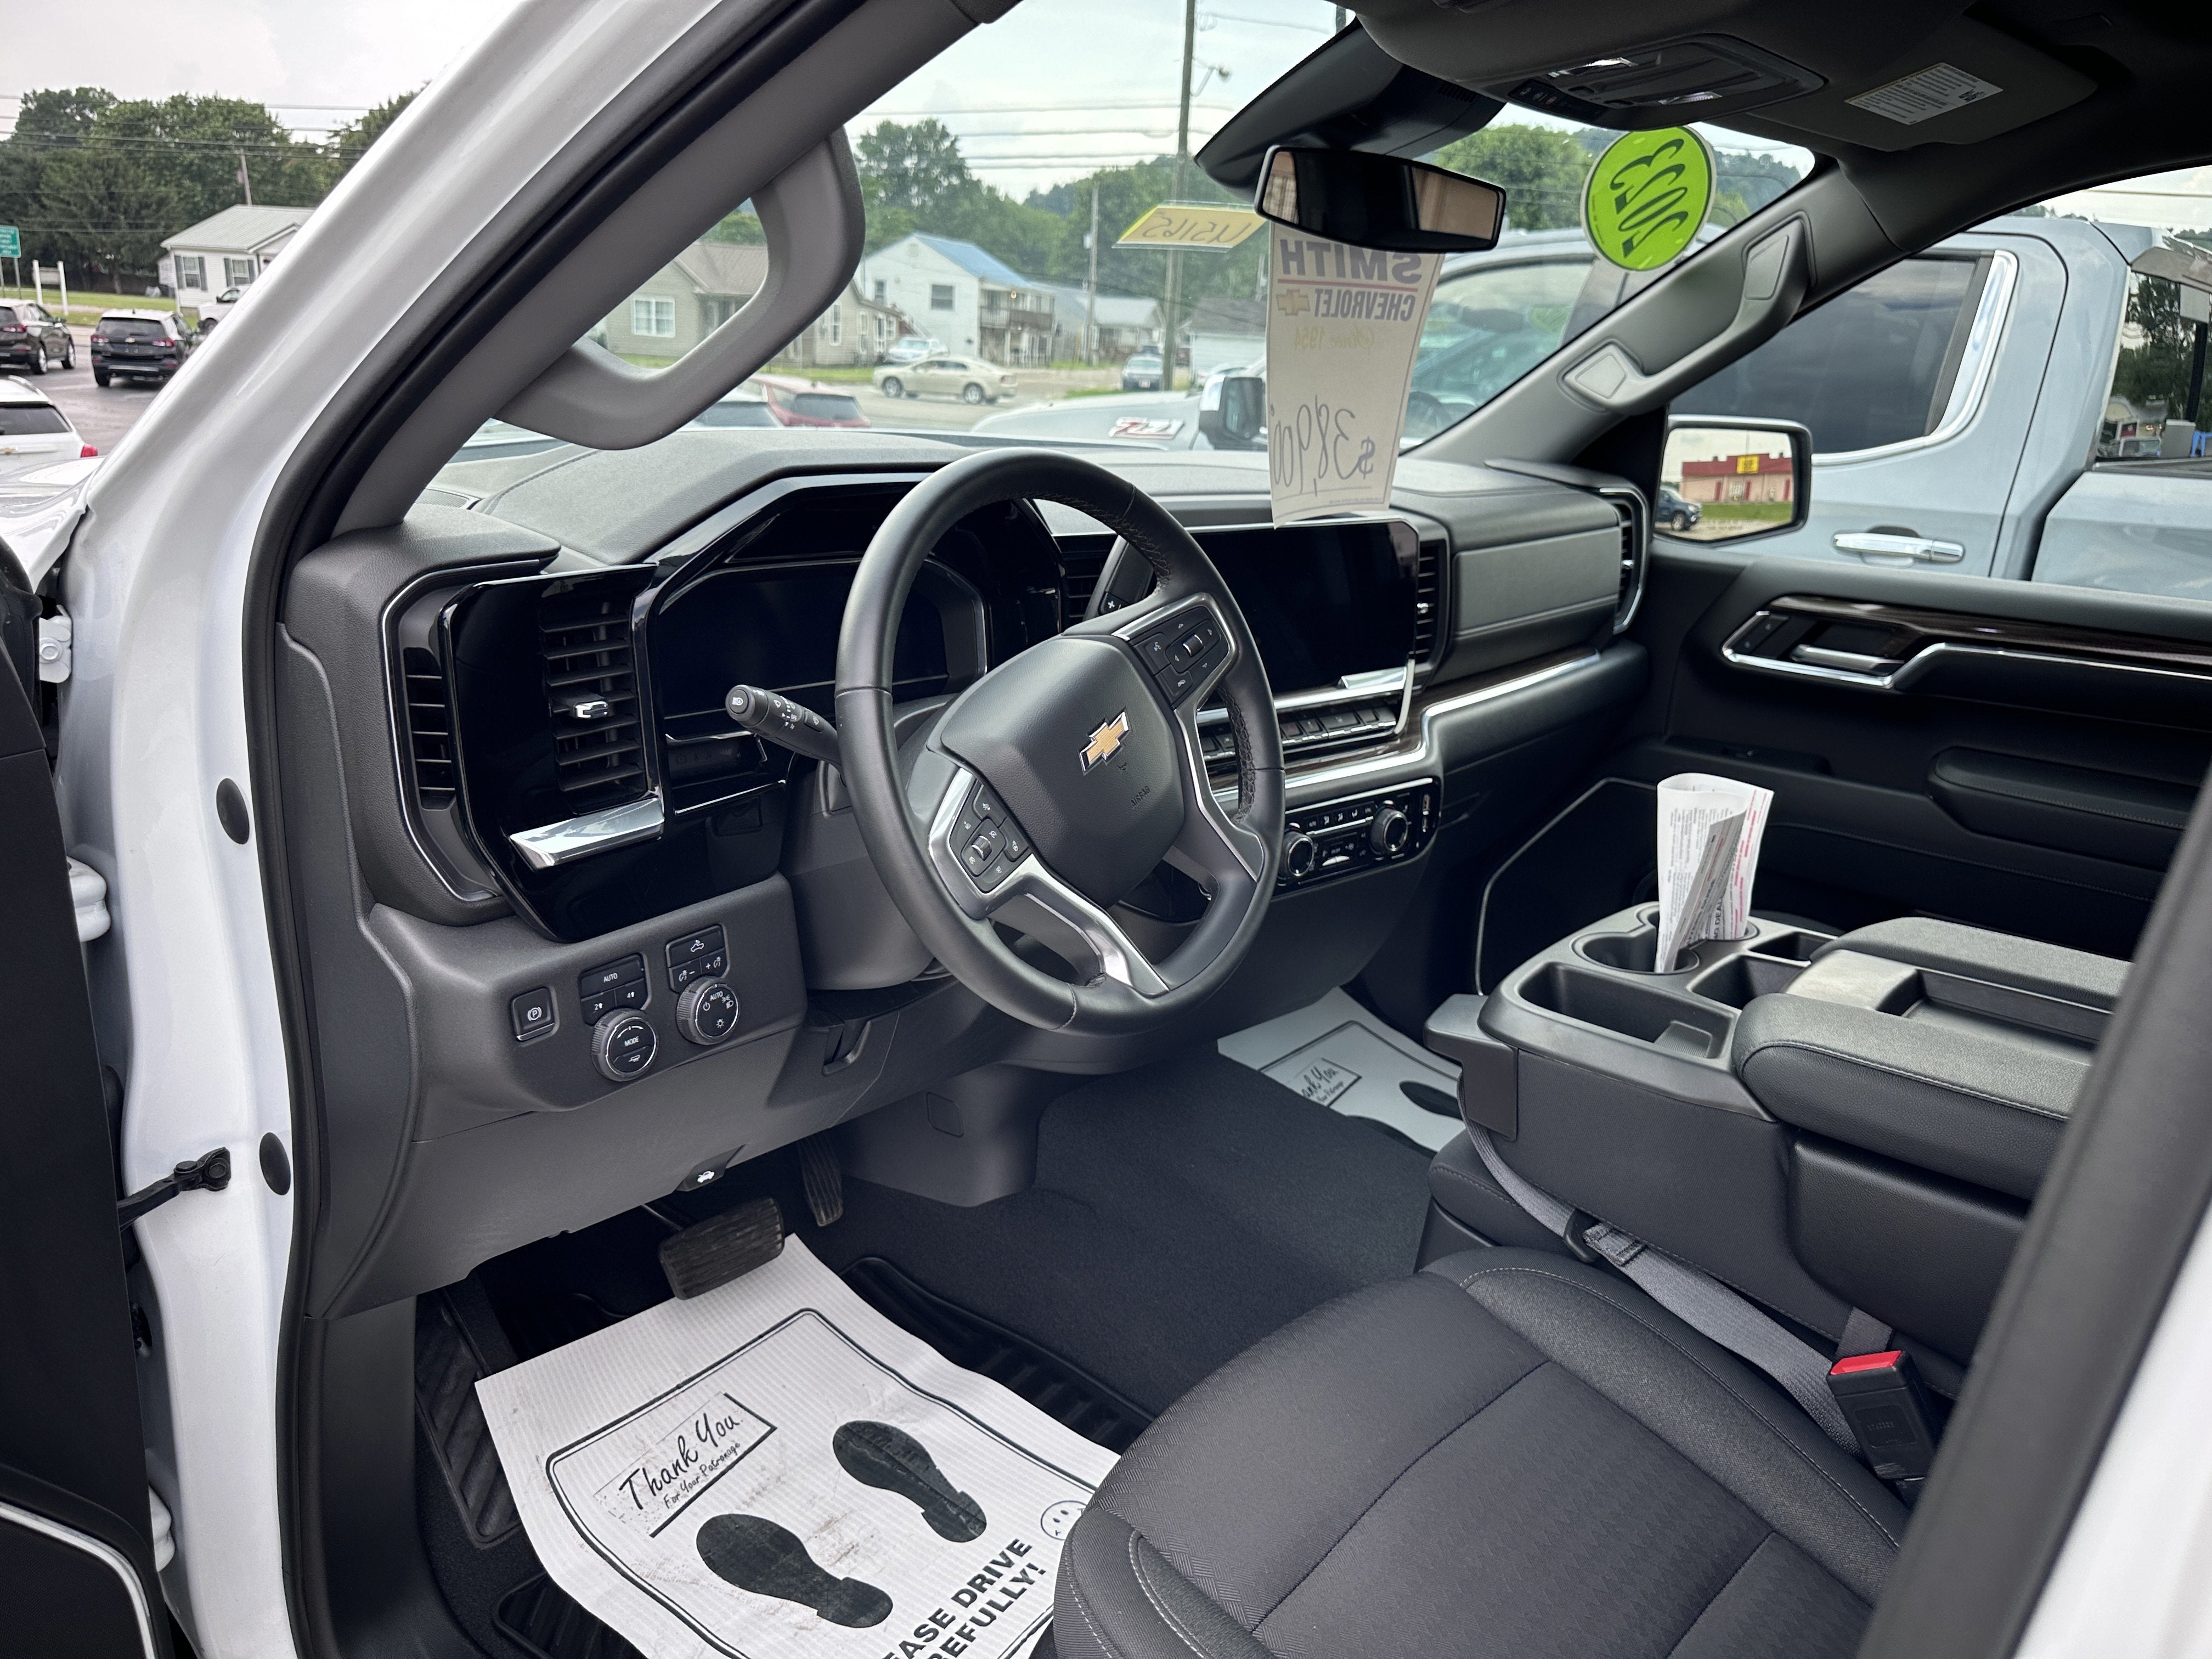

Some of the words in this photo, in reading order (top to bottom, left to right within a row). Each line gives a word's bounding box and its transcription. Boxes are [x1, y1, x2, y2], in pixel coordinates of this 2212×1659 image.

[603, 973, 618, 983] AUTO
[710, 991, 723, 1001] AUTO
[624, 1036, 640, 1047] MODE
[618, 1435, 698, 1510] Thank
[695, 1412, 740, 1447] You
[663, 1493, 681, 1509] For
[680, 1480, 701, 1493] Your
[699, 1442, 741, 1477] Patronage
[951, 1538, 1032, 1609] DRIVE
